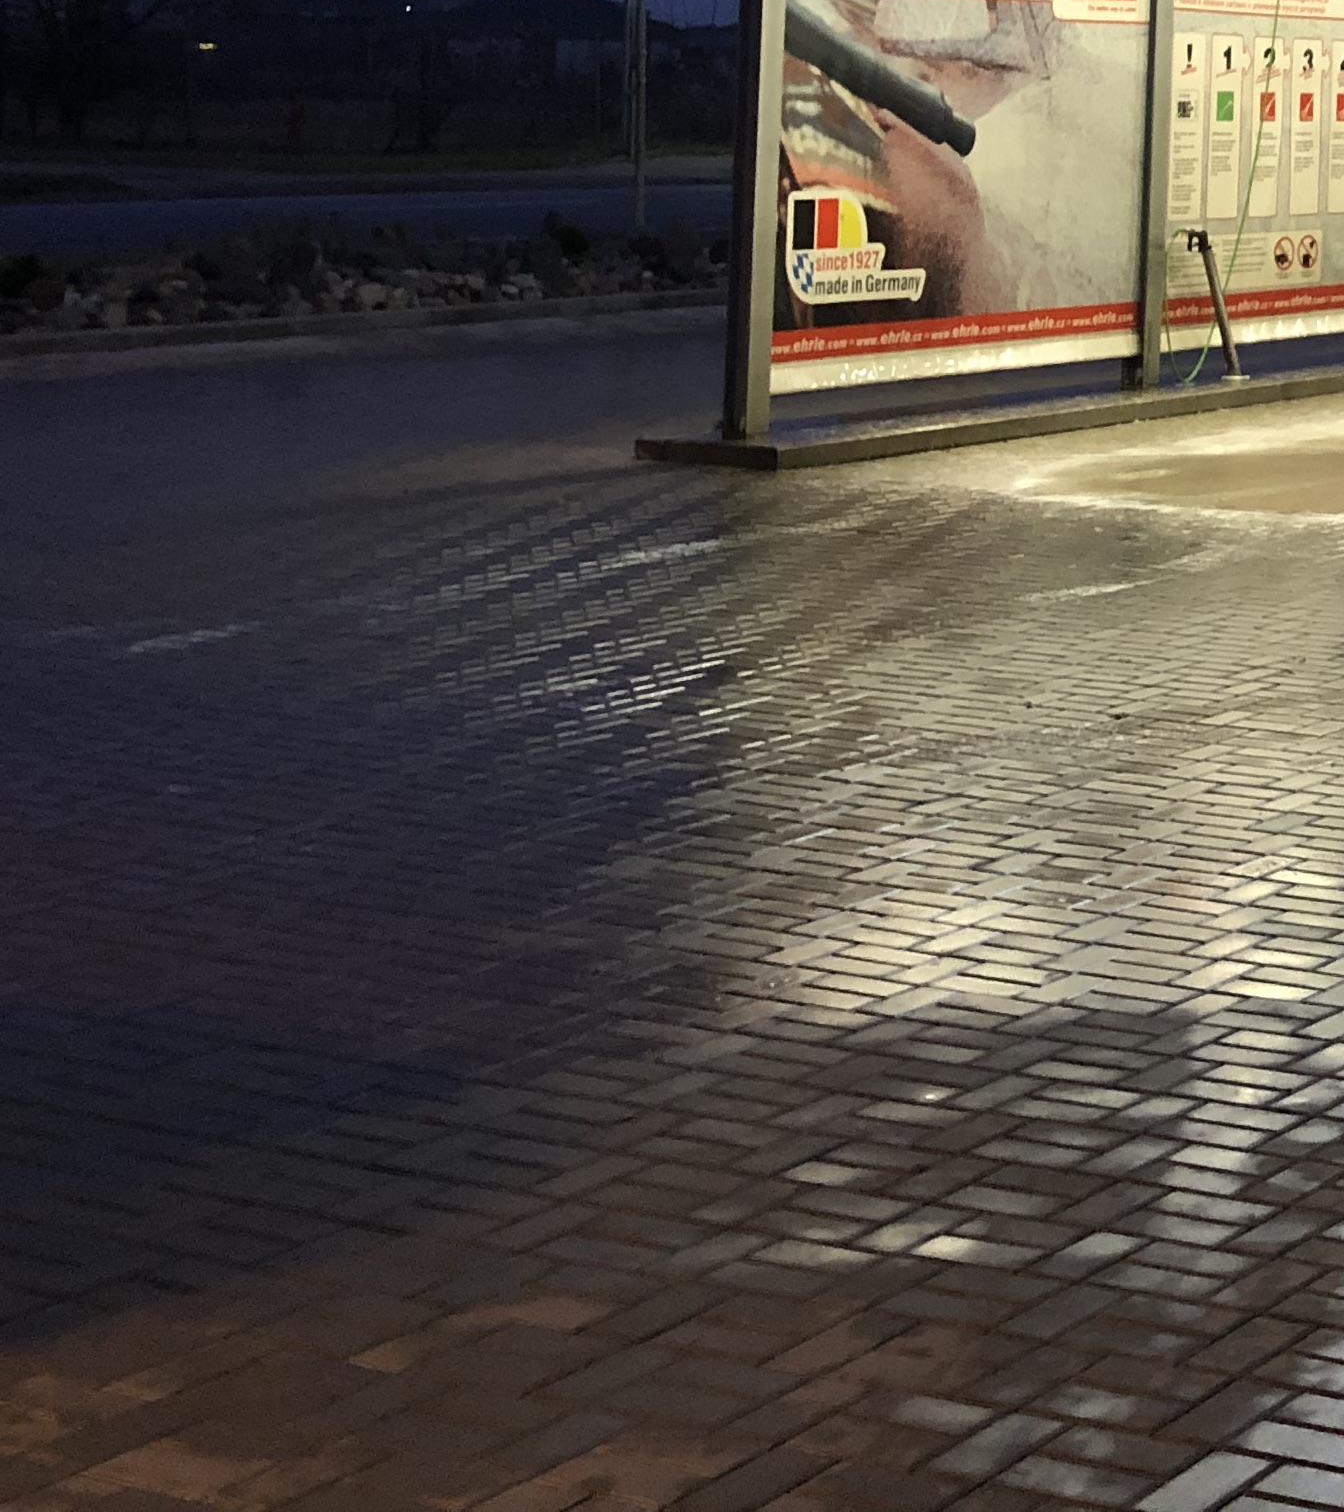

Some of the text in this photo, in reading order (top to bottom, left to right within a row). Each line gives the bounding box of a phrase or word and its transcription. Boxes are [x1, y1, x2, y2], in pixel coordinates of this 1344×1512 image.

[1223, 45, 1233, 71] 1
[1302, 48, 1315, 73] 3
[814, 273, 921, 295] made in Germany
